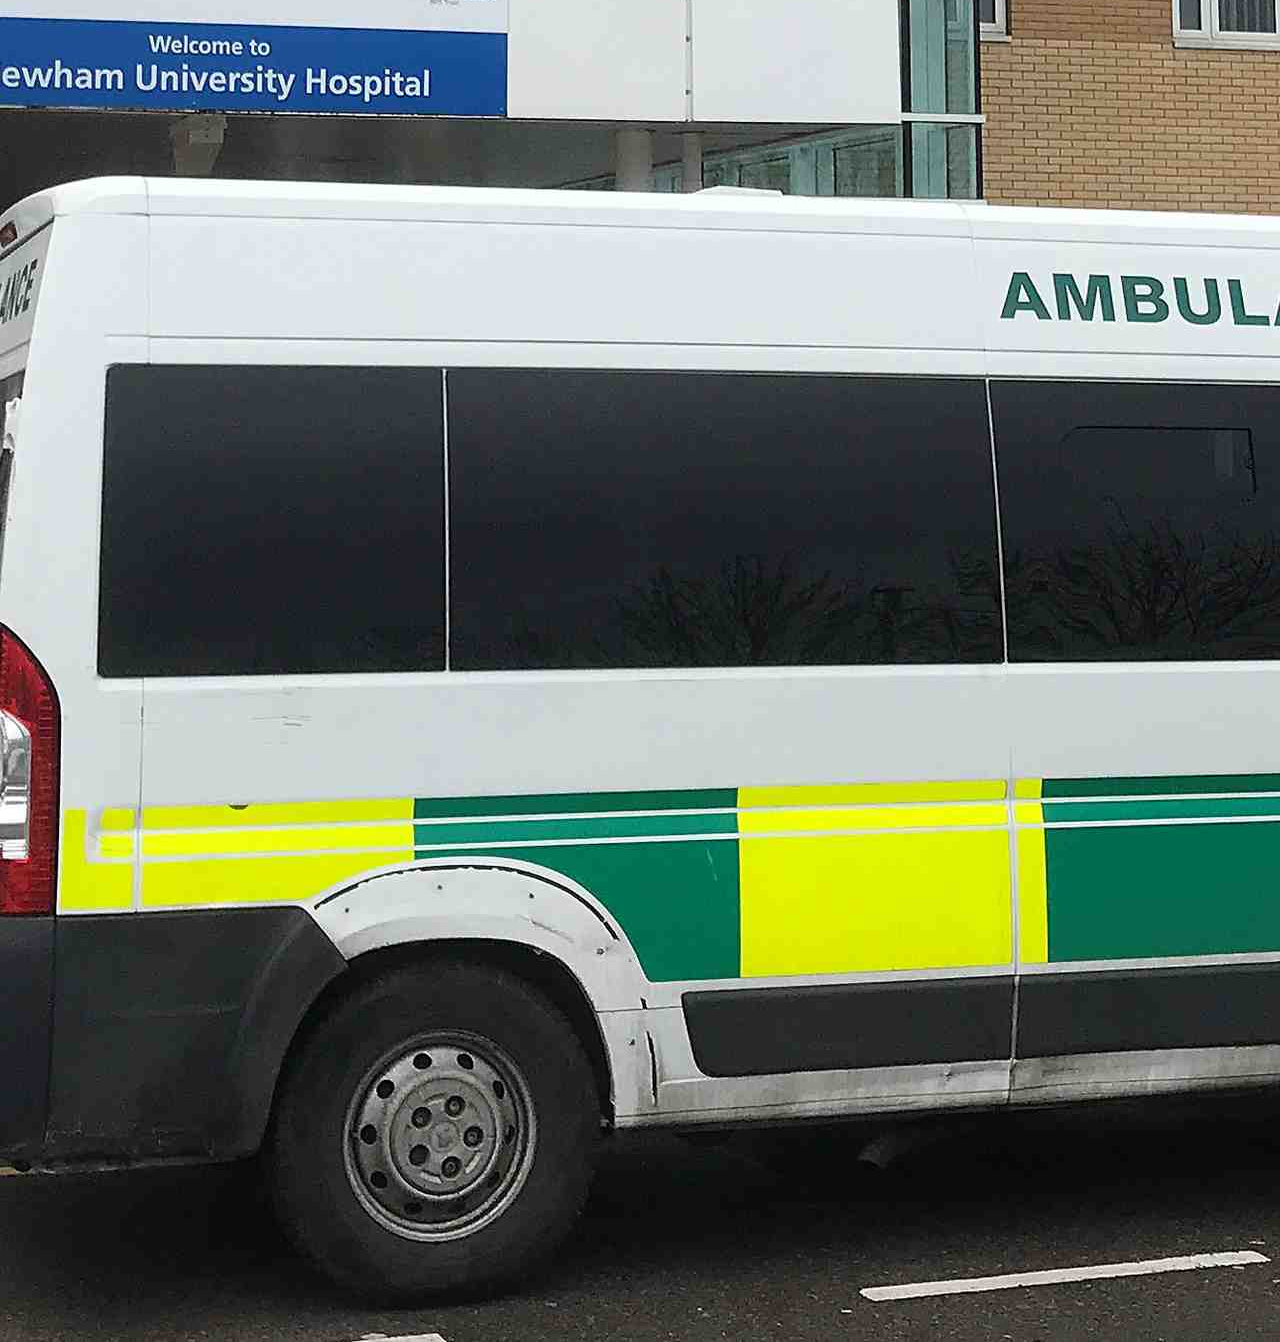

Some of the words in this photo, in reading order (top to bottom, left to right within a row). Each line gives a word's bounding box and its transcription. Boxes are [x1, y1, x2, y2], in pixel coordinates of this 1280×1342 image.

[148, 34, 243, 55] Welcome
[249, 39, 271, 56] to
[136, 63, 296, 101] University
[305, 67, 430, 102] Hospital
